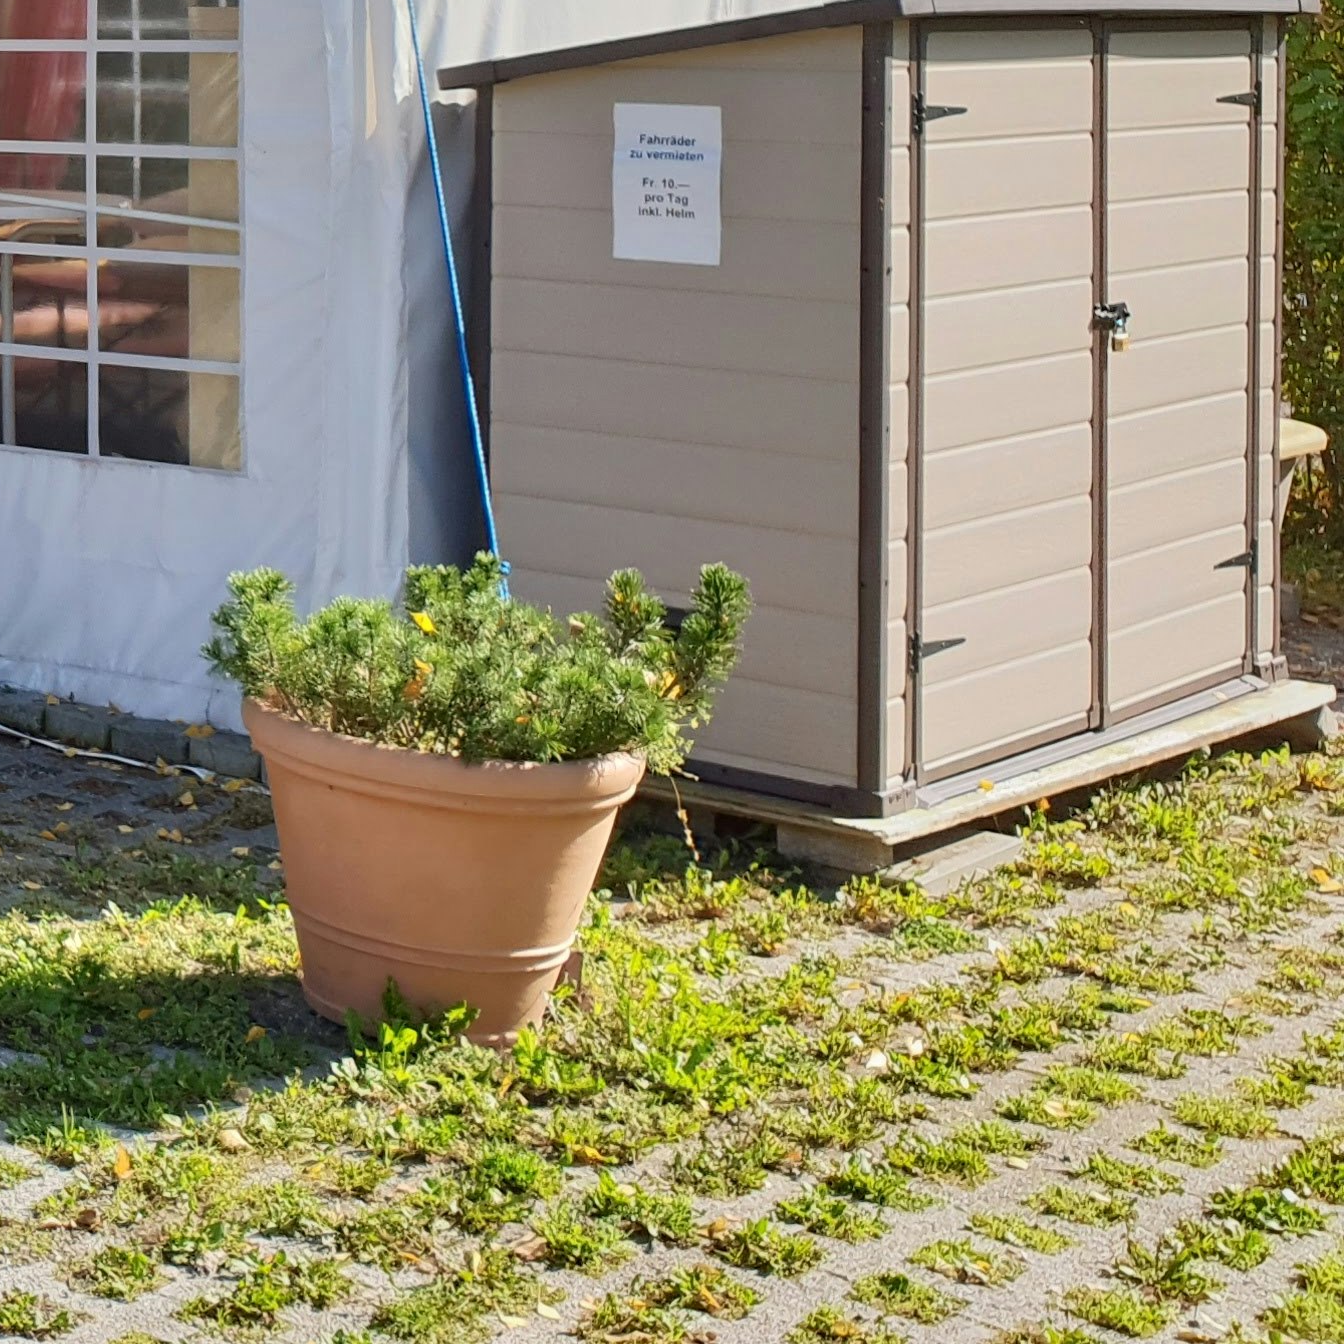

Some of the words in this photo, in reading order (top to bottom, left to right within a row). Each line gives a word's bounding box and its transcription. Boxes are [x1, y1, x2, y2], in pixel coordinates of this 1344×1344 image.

[639, 133, 696, 147] Fahrräder
[630, 150, 643, 159] zu
[647, 149, 704, 161] vermieten
[642, 177, 657, 188] Fr.
[644, 193, 664, 204] pro
[667, 193, 689, 206] Tag
[638, 206, 662, 217] inkl.
[666, 207, 695, 219] Helm
